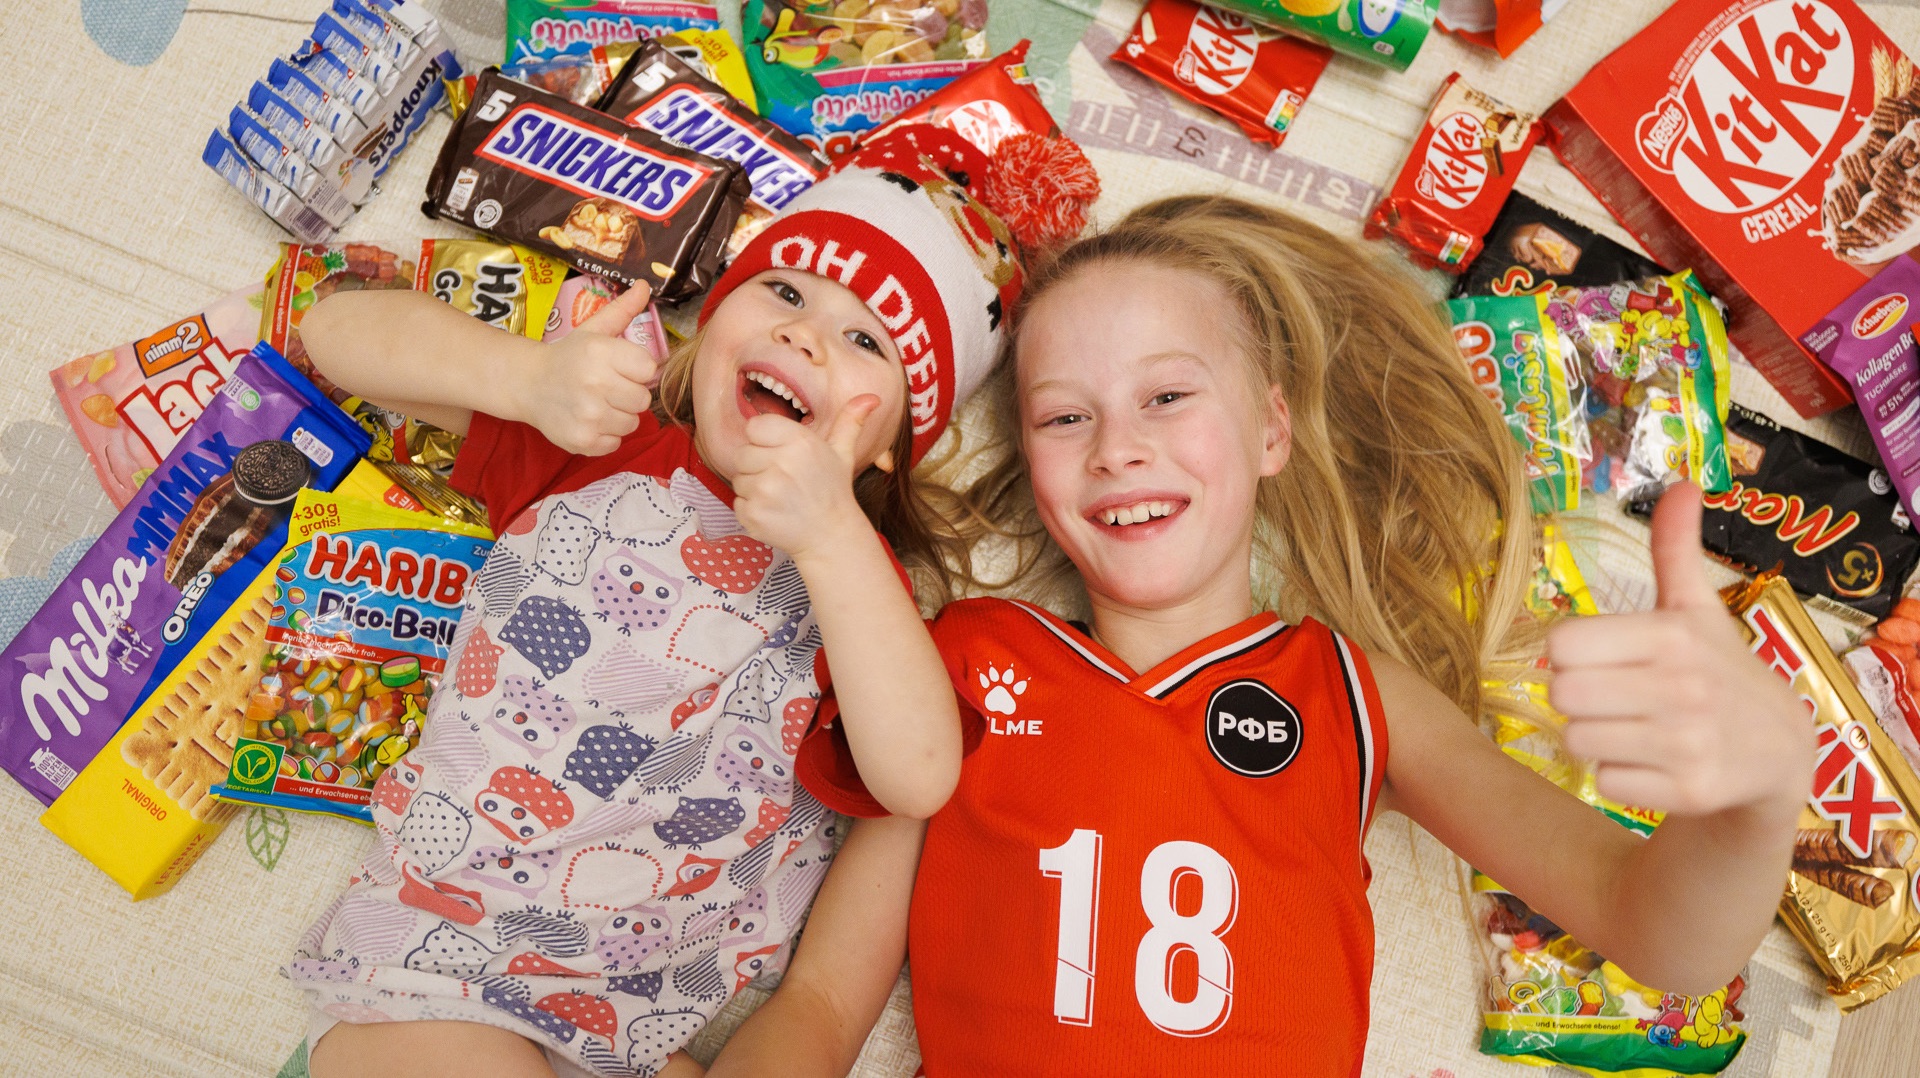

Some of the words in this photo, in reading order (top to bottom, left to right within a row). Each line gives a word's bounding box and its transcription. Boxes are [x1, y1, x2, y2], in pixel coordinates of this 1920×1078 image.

[632, 61, 678, 92] 5
[369, 57, 442, 167] Knoppers
[476, 89, 516, 122] 5
[1681, 2, 1846, 208] KitKat
[494, 113, 693, 212] SNICKERS
[648, 95, 814, 211] SNICKER
[1428, 116, 1486, 204] KitKat
[1741, 193, 1817, 243] CEREAL
[577, 257, 584, 267] 5
[771, 233, 867, 287] OH
[145, 321, 203, 363] nimm2
[1856, 342, 1903, 388] Kollagen
[1864, 361, 1908, 401] TUCHMASKE
[300, 516, 341, 536] gratis!
[308, 535, 478, 605] HARIB
[163, 574, 212, 641] OREO
[317, 590, 458, 646] Pico-Ball
[21, 556, 147, 742] Milka
[361, 648, 376, 658] froh
[987, 716, 1043, 736] LME
[1218, 711, 1288, 744] РФБ
[37, 755, 55, 773] 100%
[45, 759, 62, 779] ALPEN
[51, 764, 69, 785] MILCH
[121, 778, 167, 822] ORIGINAL
[299, 785, 313, 795] und
[315, 788, 358, 801] Erwachsene
[1623, 805, 1660, 823] XXL
[155, 833, 205, 885] LEIBNIZ
[1039, 828, 1239, 1038] 18
[1838, 954, 1852, 972] 250
[1535, 1020, 1551, 1029] und
[1552, 1020, 1590, 1031] Erwachsene
[1591, 1023, 1621, 1031] ebenso!
